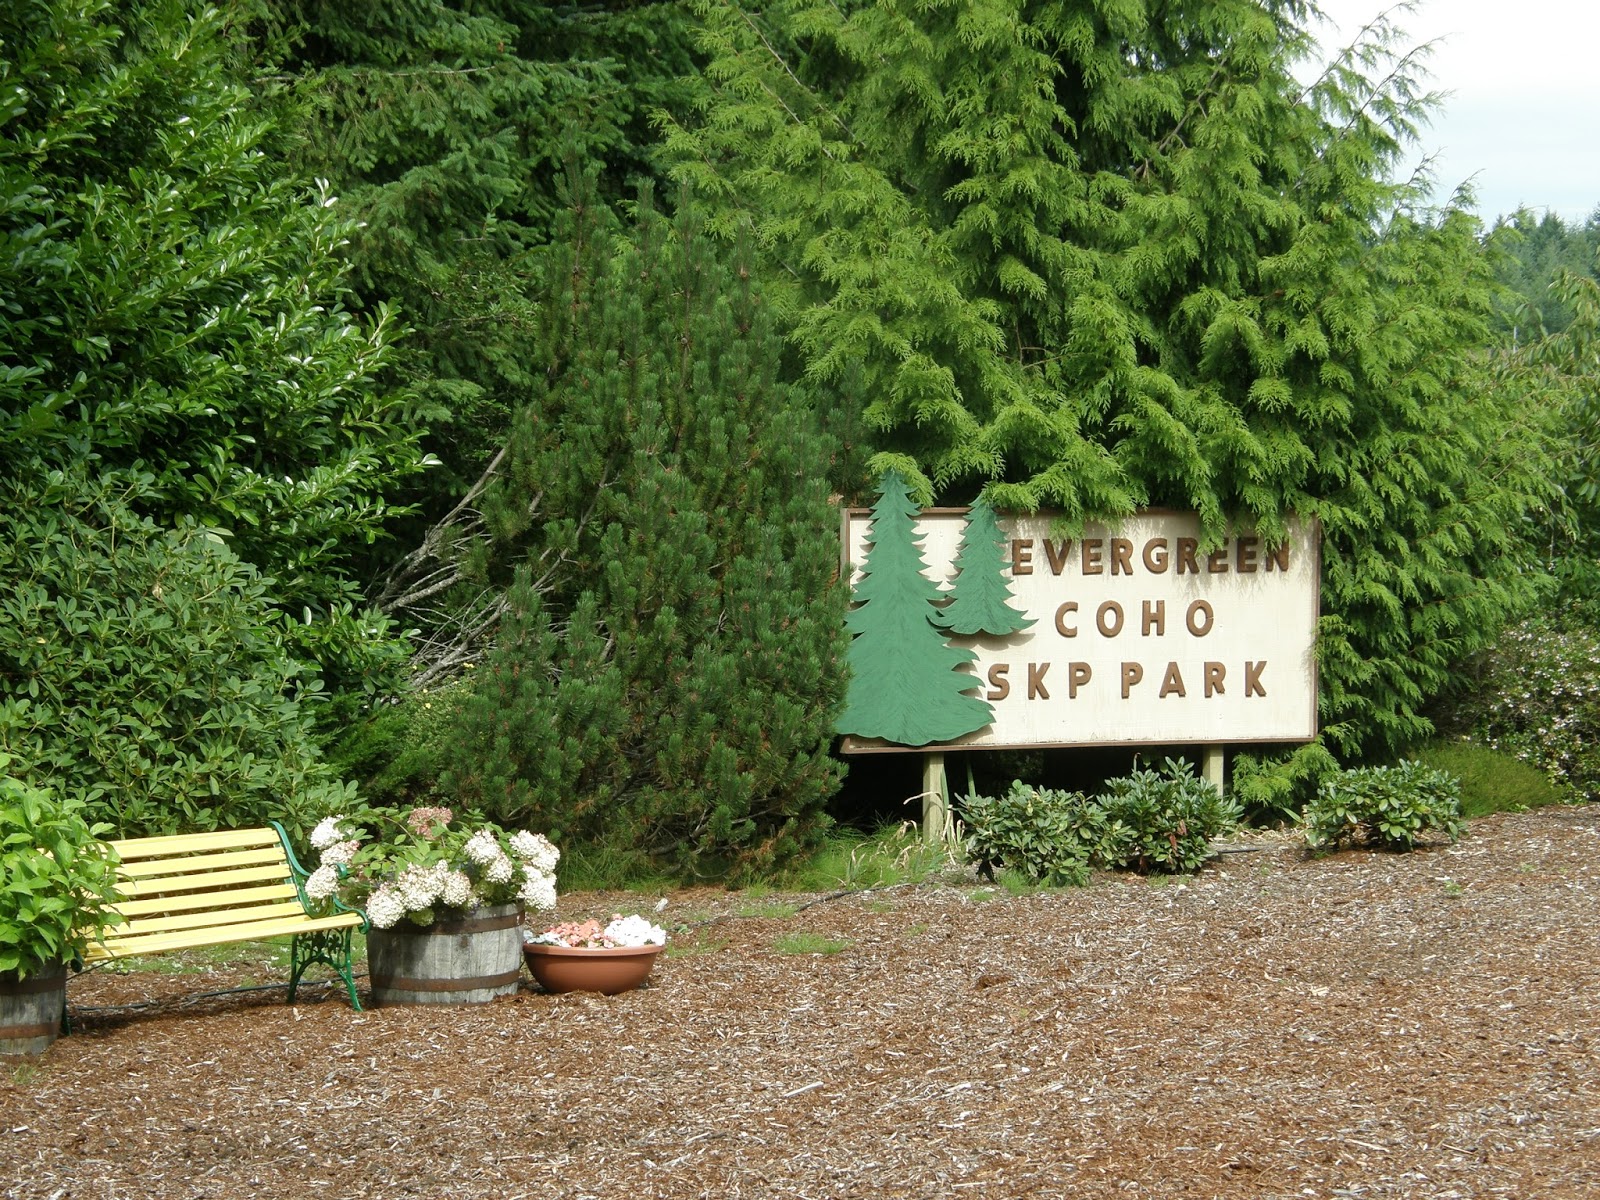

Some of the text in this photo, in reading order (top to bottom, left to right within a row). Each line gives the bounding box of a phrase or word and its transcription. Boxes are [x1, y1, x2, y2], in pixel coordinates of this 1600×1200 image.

[1012, 537, 1290, 576] EVERGREEN
[1054, 599, 1214, 638] COHO
[987, 660, 1268, 701] SKP PARK
